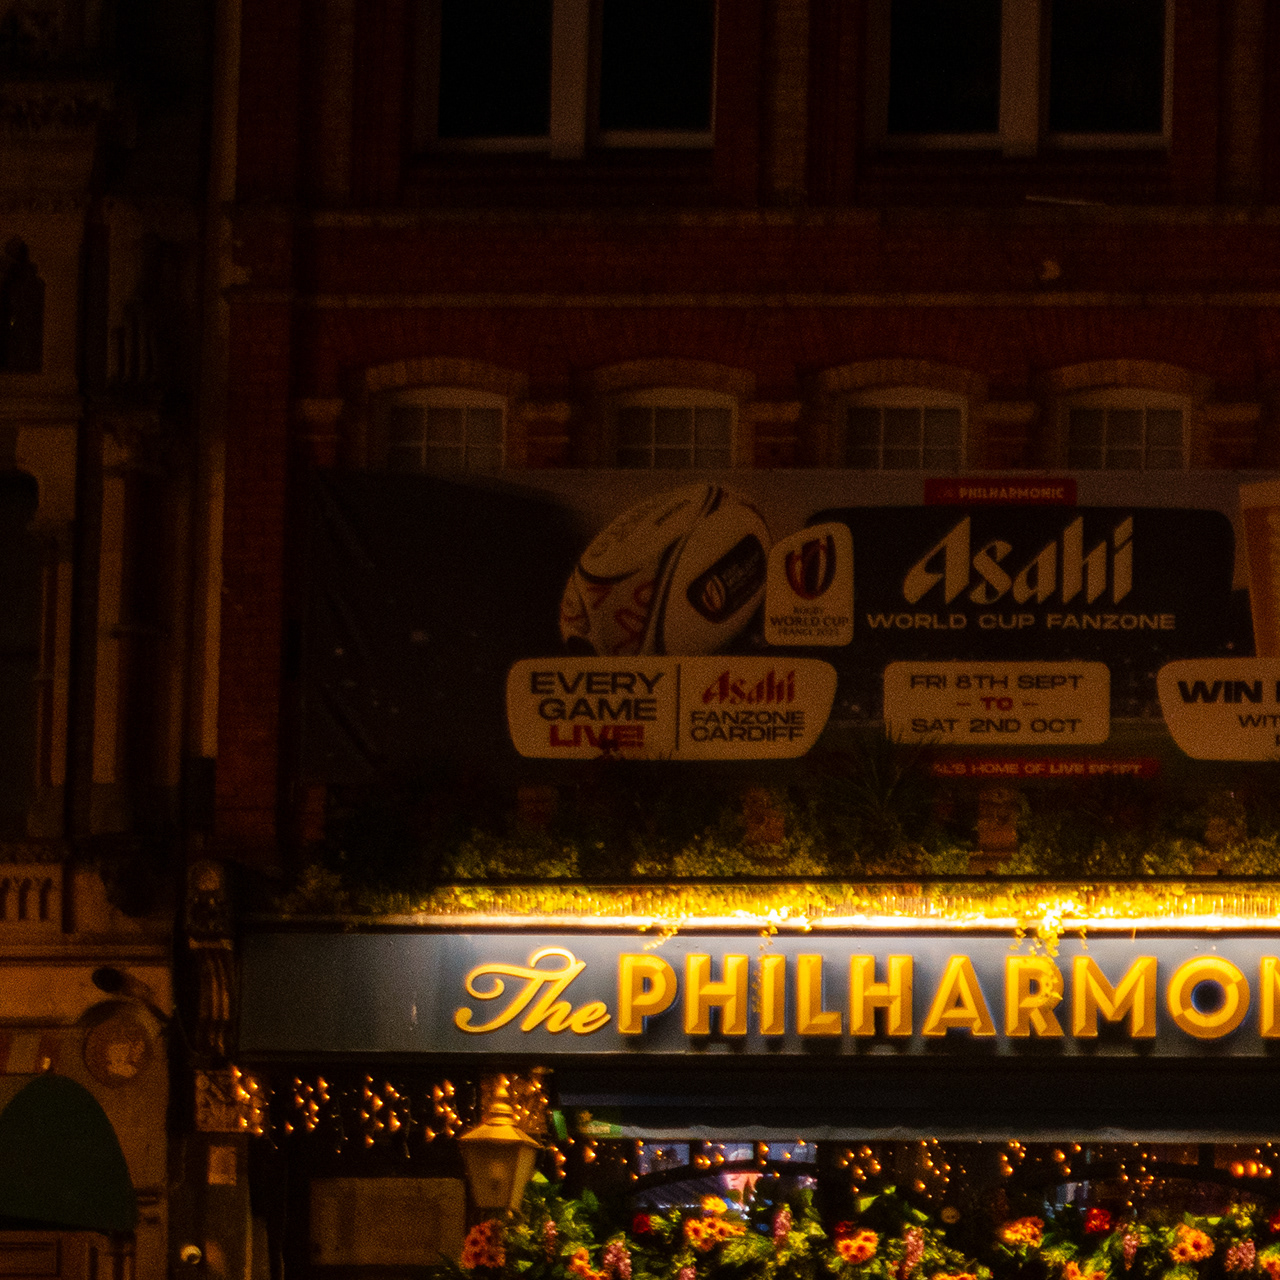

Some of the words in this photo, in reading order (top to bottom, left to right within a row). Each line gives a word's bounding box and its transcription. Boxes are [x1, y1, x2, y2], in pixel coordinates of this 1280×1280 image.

[902, 514, 1134, 606] Asahi
[769, 616, 820, 627] WORLD
[823, 616, 850, 627] CUP
[866, 612, 967, 630] WORLD
[978, 612, 1036, 630] CUP
[1046, 612, 1176, 631] FANZONE
[531, 672, 665, 695] EVERY
[702, 670, 796, 704] Asahi
[910, 674, 947, 689] FRI
[955, 674, 1008, 690] 8TH
[1017, 675, 1084, 689] SEPT
[1178, 681, 1263, 704] WIN
[538, 698, 658, 721] GAME
[980, 697, 1013, 711] TO
[690, 711, 805, 726] FANZONE
[911, 718, 959, 733] SAT
[969, 719, 1021, 733] 2ND
[1030, 718, 1082, 733] OCT
[690, 726, 805, 742] CARDIFF
[971, 762, 1019, 775] HOME
[1023, 762, 1045, 775] OF
[1049, 762, 1085, 775] LIVE
[453, 946, 612, 1035] The
